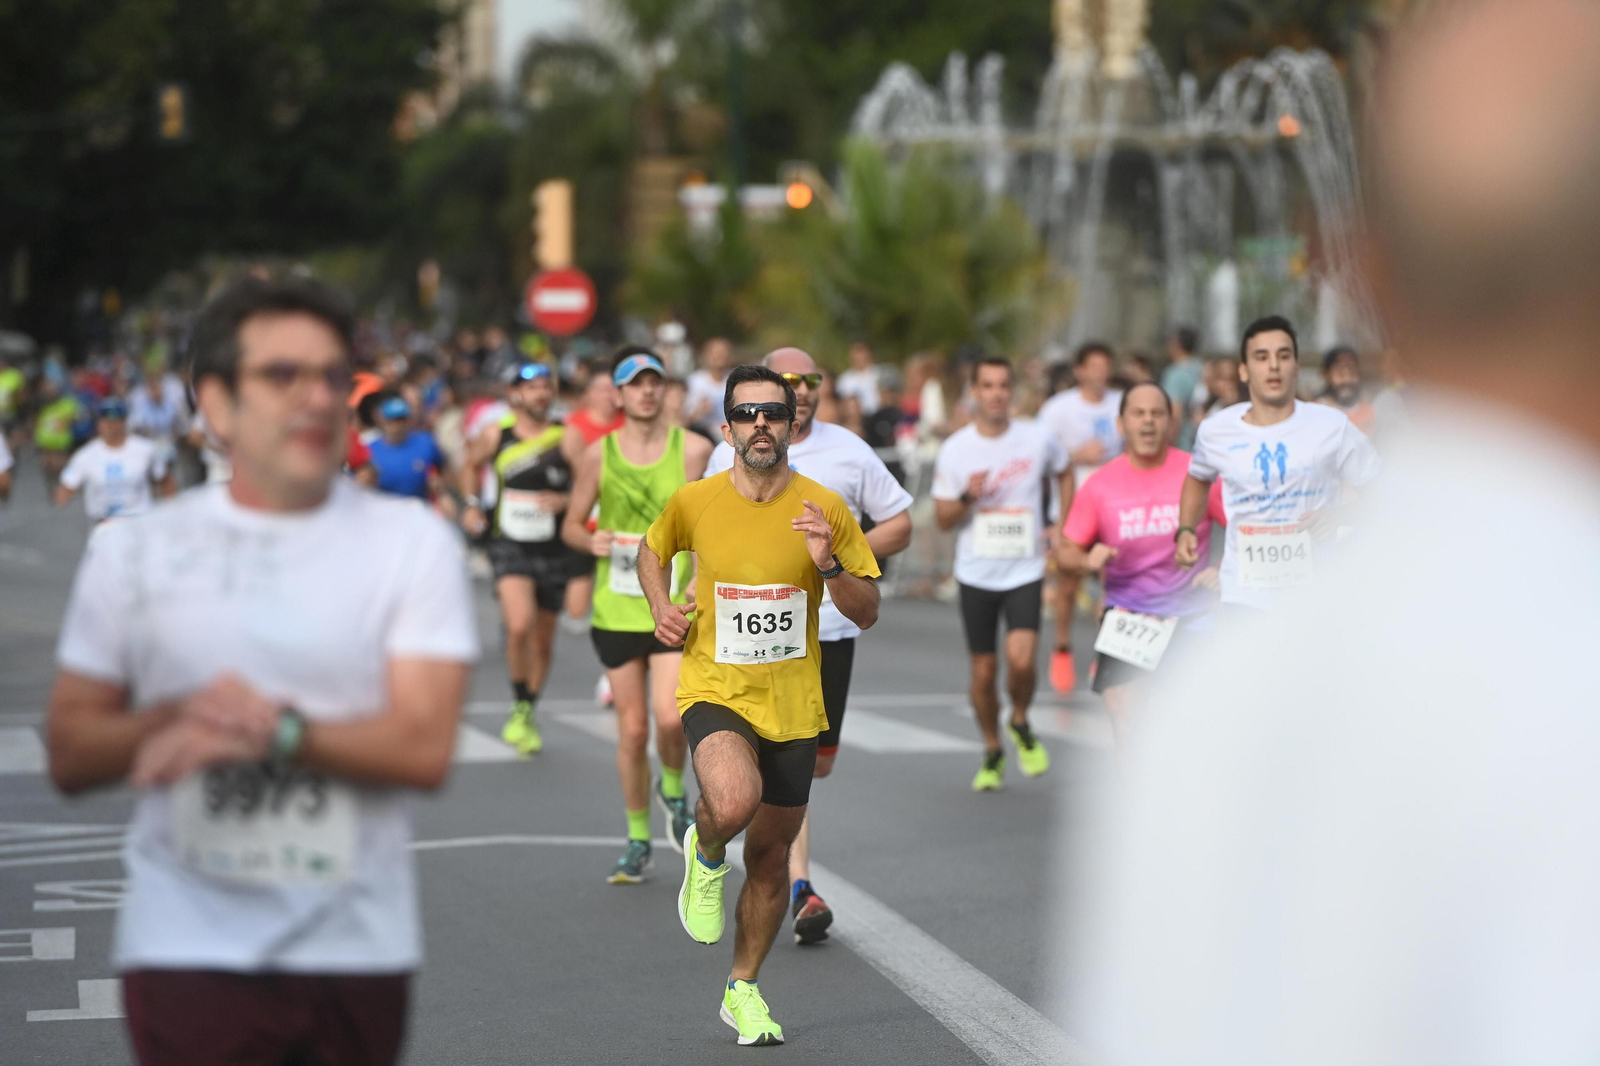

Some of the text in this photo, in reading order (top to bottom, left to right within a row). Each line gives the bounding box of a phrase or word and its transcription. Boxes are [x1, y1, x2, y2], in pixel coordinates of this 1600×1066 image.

[1118, 506, 1145, 521] WE
[1245, 543, 1307, 562] 11904
[717, 586, 739, 600] 42
[732, 610, 793, 635] 1635
[1115, 616, 1161, 645] 9277
